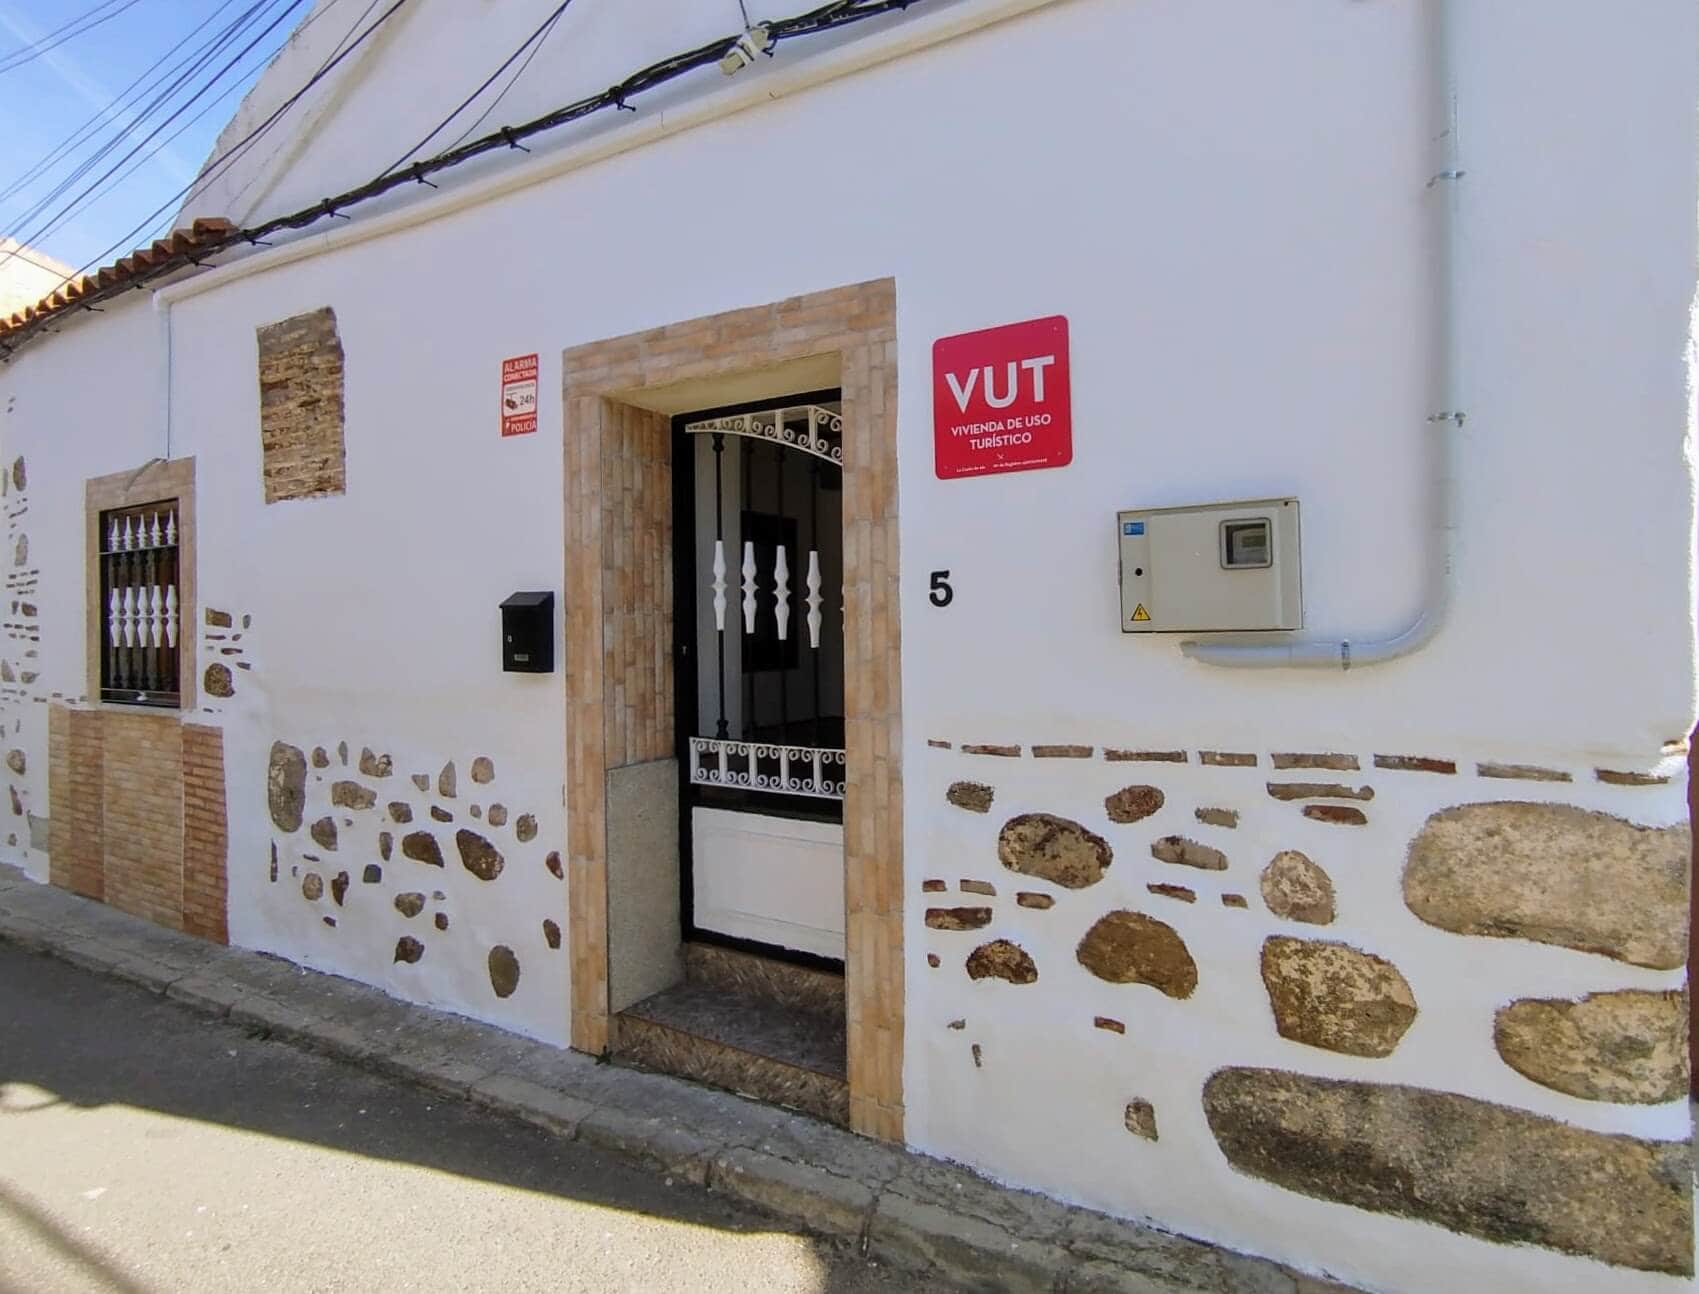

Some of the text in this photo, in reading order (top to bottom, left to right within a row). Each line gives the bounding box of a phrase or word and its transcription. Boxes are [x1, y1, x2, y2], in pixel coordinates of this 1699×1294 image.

[504, 357, 537, 374] ALARMA
[945, 355, 1055, 414] VUT
[519, 394, 535, 406] 24h
[951, 414, 1051, 437] VIVIENDA DE USO
[970, 432, 1032, 450] TURÍSTICO
[929, 569, 953, 607] 5
